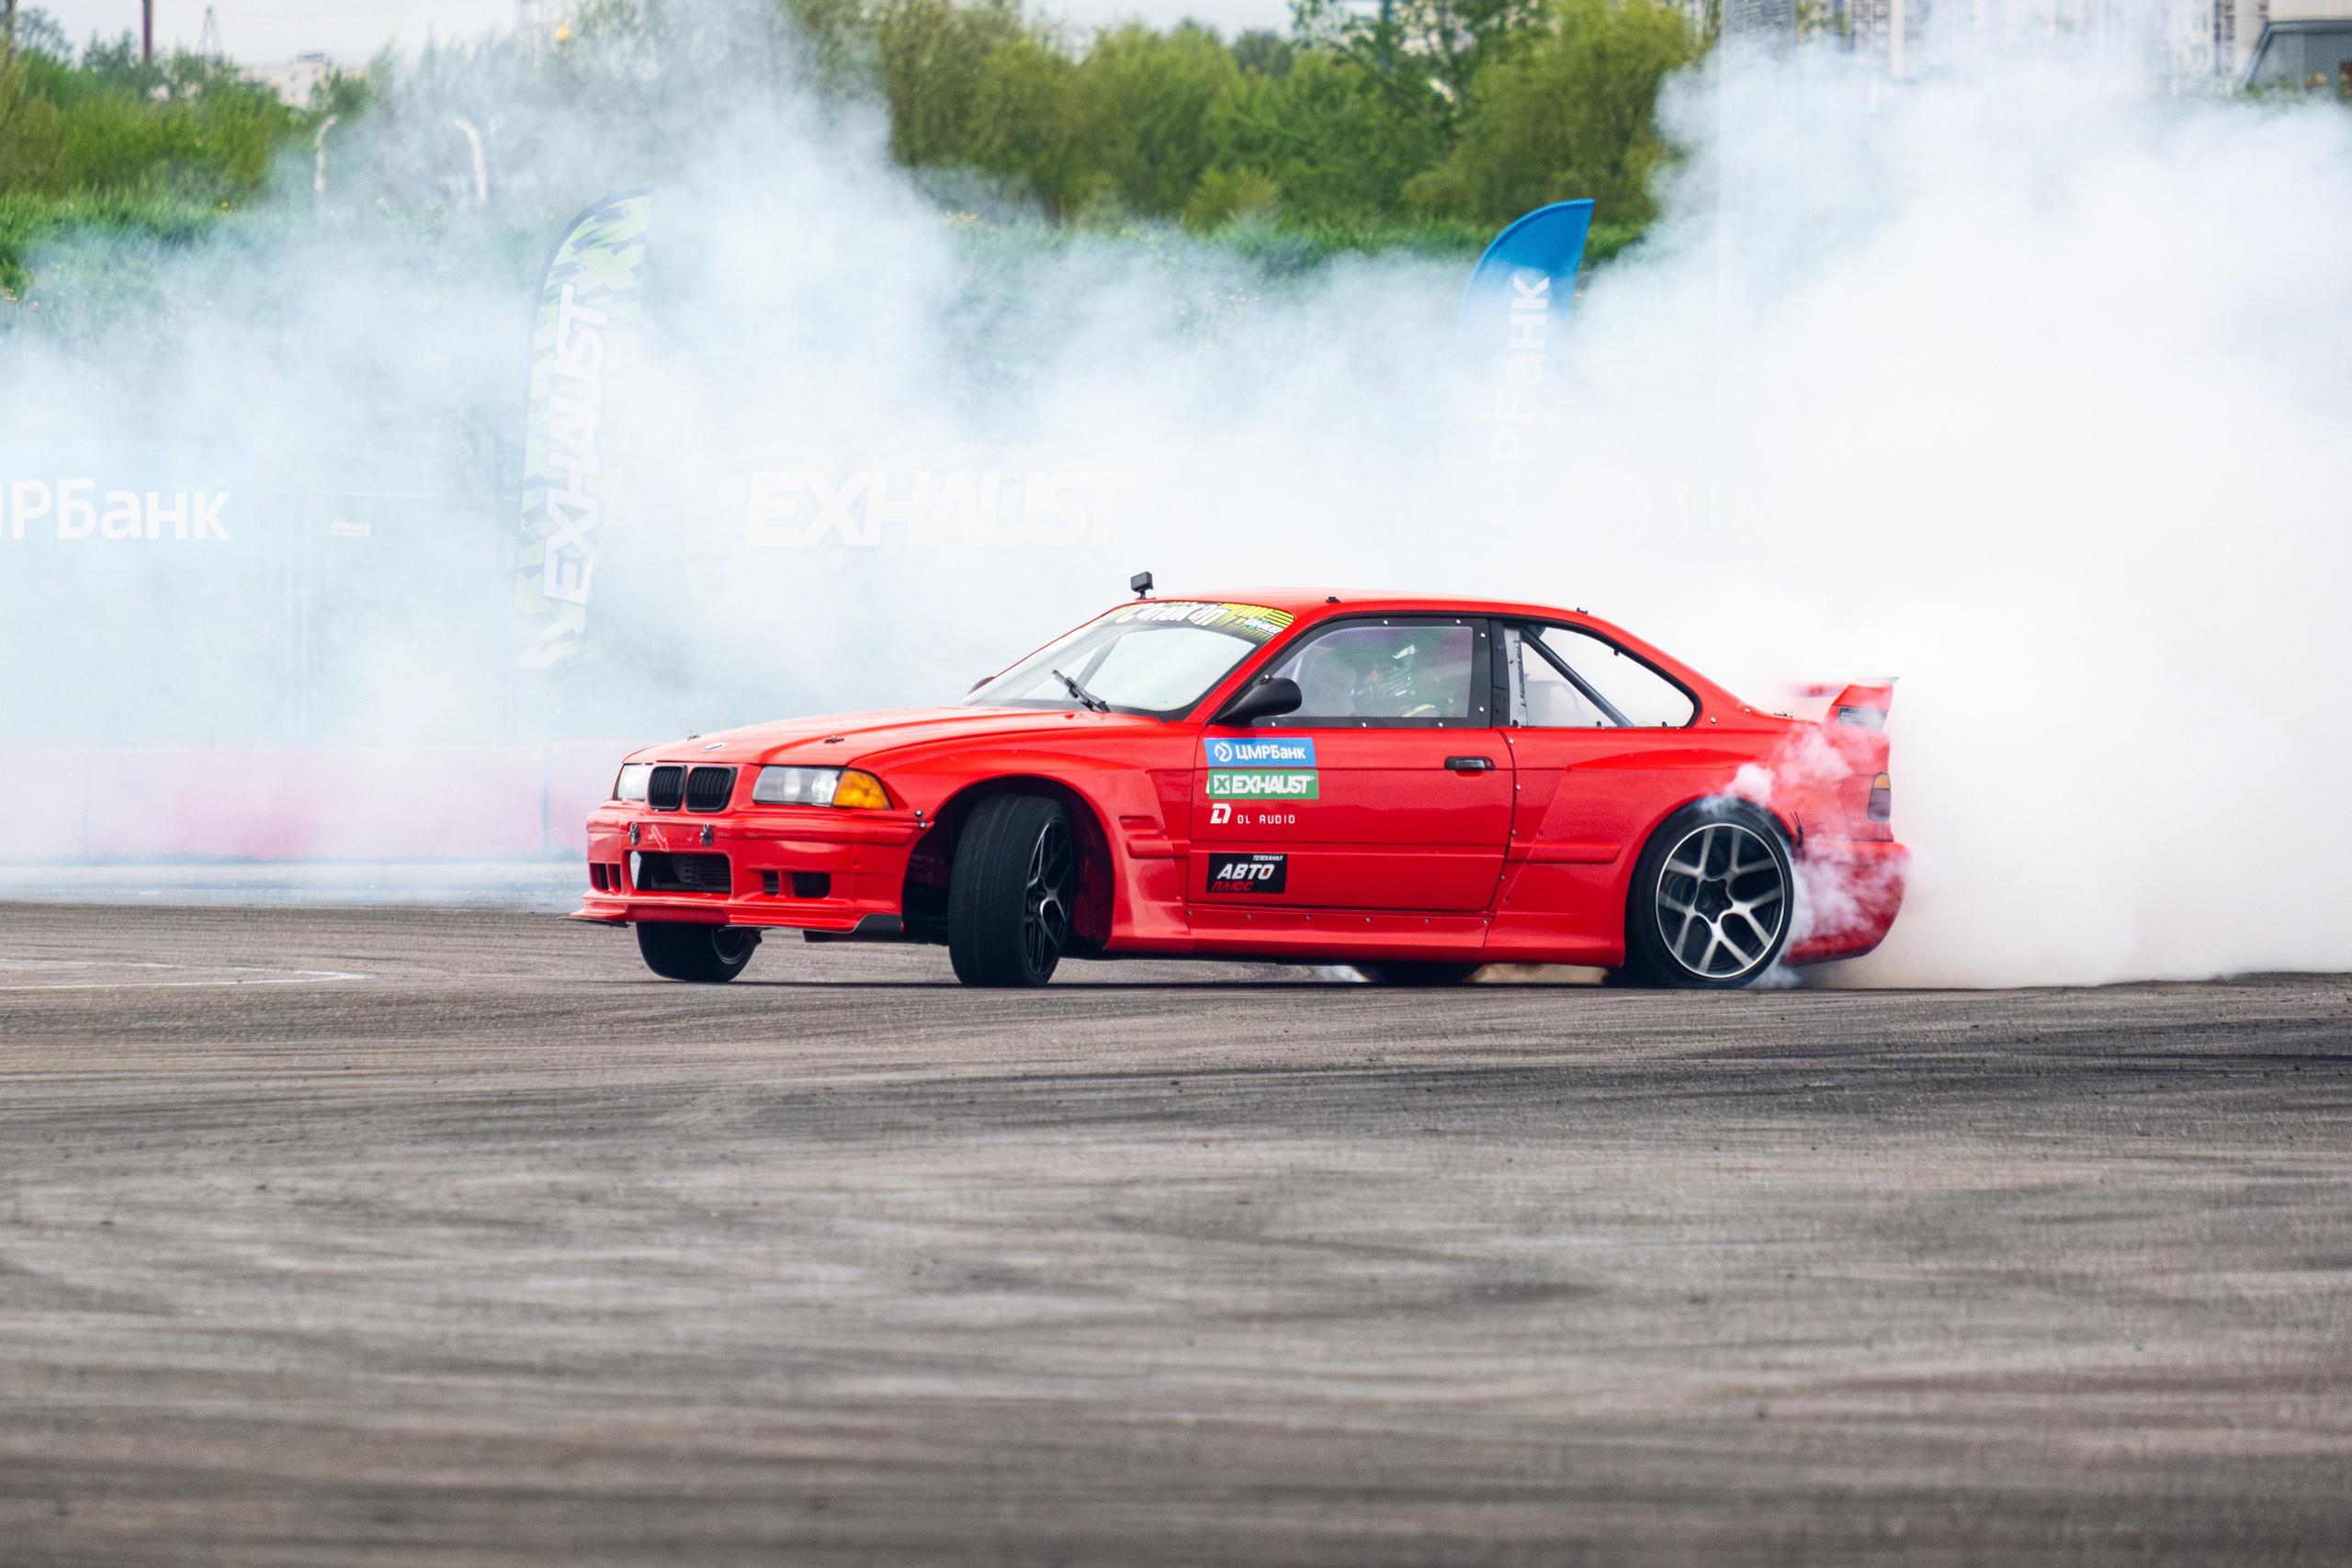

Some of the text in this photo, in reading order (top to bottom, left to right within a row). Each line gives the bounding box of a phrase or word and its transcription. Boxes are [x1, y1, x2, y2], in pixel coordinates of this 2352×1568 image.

[543, 283, 607, 605] EXHAUST
[0, 478, 232, 540] РБанк
[743, 470, 1137, 547] EXHAUST
[1235, 745, 1306, 761] ЦМРБанк
[1232, 775, 1311, 794] EXHAUST
[1237, 815, 1250, 824] DL
[1259, 815, 1295, 824] AUDIO
[1216, 863, 1275, 880] АВТО
[1212, 881, 1253, 891] ПЛЮС
